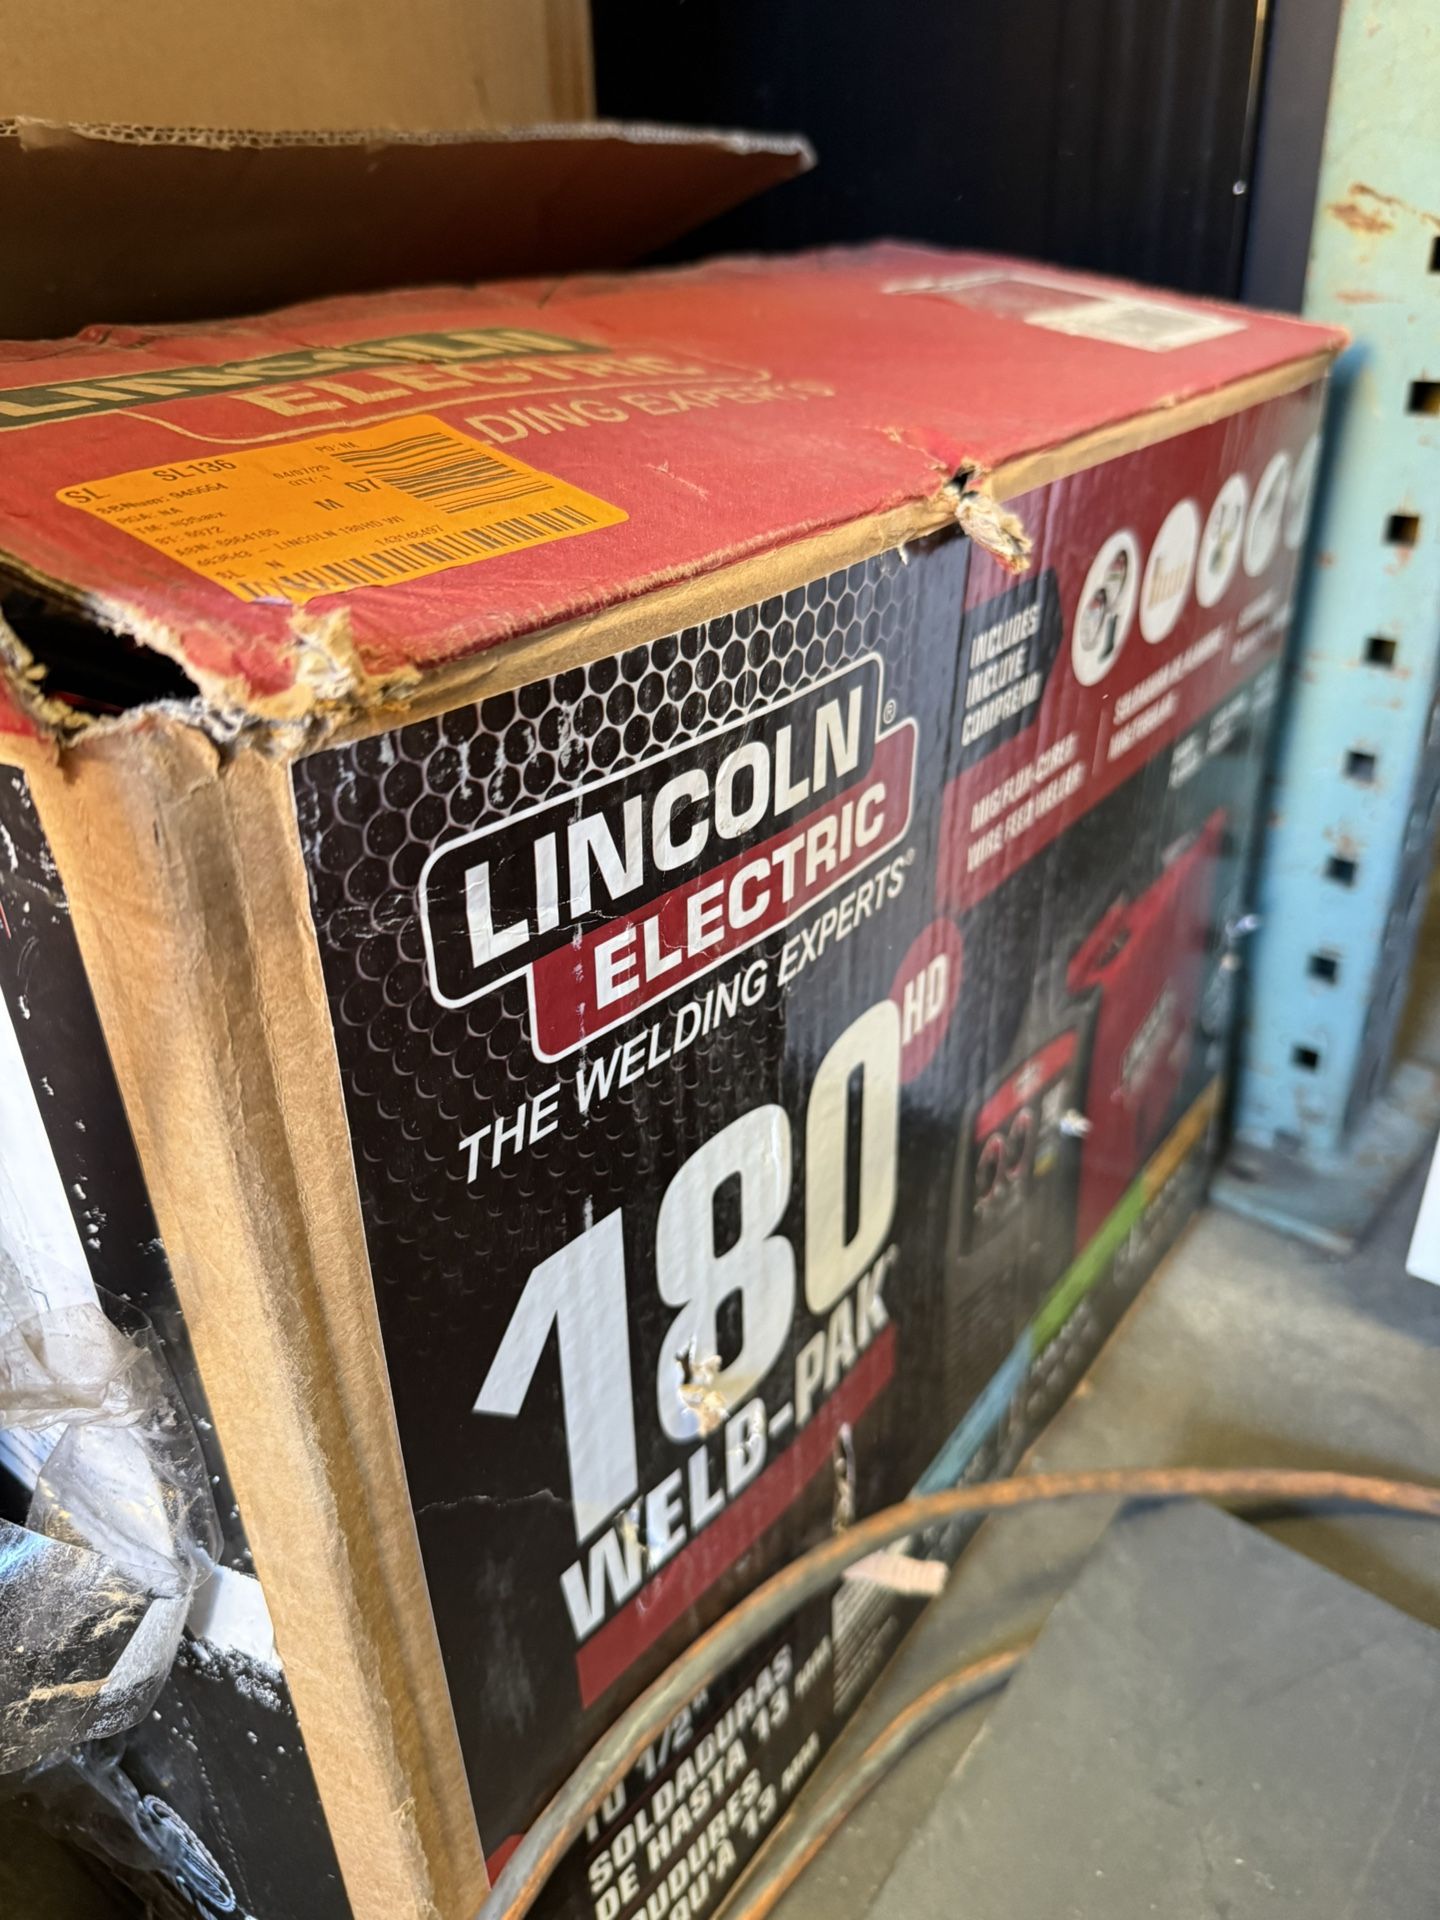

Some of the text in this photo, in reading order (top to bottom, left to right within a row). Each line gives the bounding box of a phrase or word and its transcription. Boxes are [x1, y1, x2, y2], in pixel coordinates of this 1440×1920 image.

[228, 355, 705, 416] ELECTRIC
[61, 485, 113, 504] SL
[151, 457, 240, 483] SL136
[311, 498, 346, 511] M
[342, 477, 386, 493] 07
[269, 529, 342, 550] LINCOLN
[970, 603, 1041, 671] INCLUDES
[464, 685, 863, 968] LINCOLN
[594, 782, 887, 1010] ELECTRIC
[903, 953, 948, 1047] HD
[458, 1082, 561, 1184] THE
[575, 958, 768, 1113] WELDING
[472, 1000, 900, 1545] 180
[561, 1256, 890, 1641] WELD-PAK
[588, 1643, 792, 1895] SOLDADURAS
[595, 1861, 640, 1920] DE
[647, 1738, 747, 1872] HASTA
[752, 1684, 790, 1743] 13
[741, 1783, 776, 1838] 13
